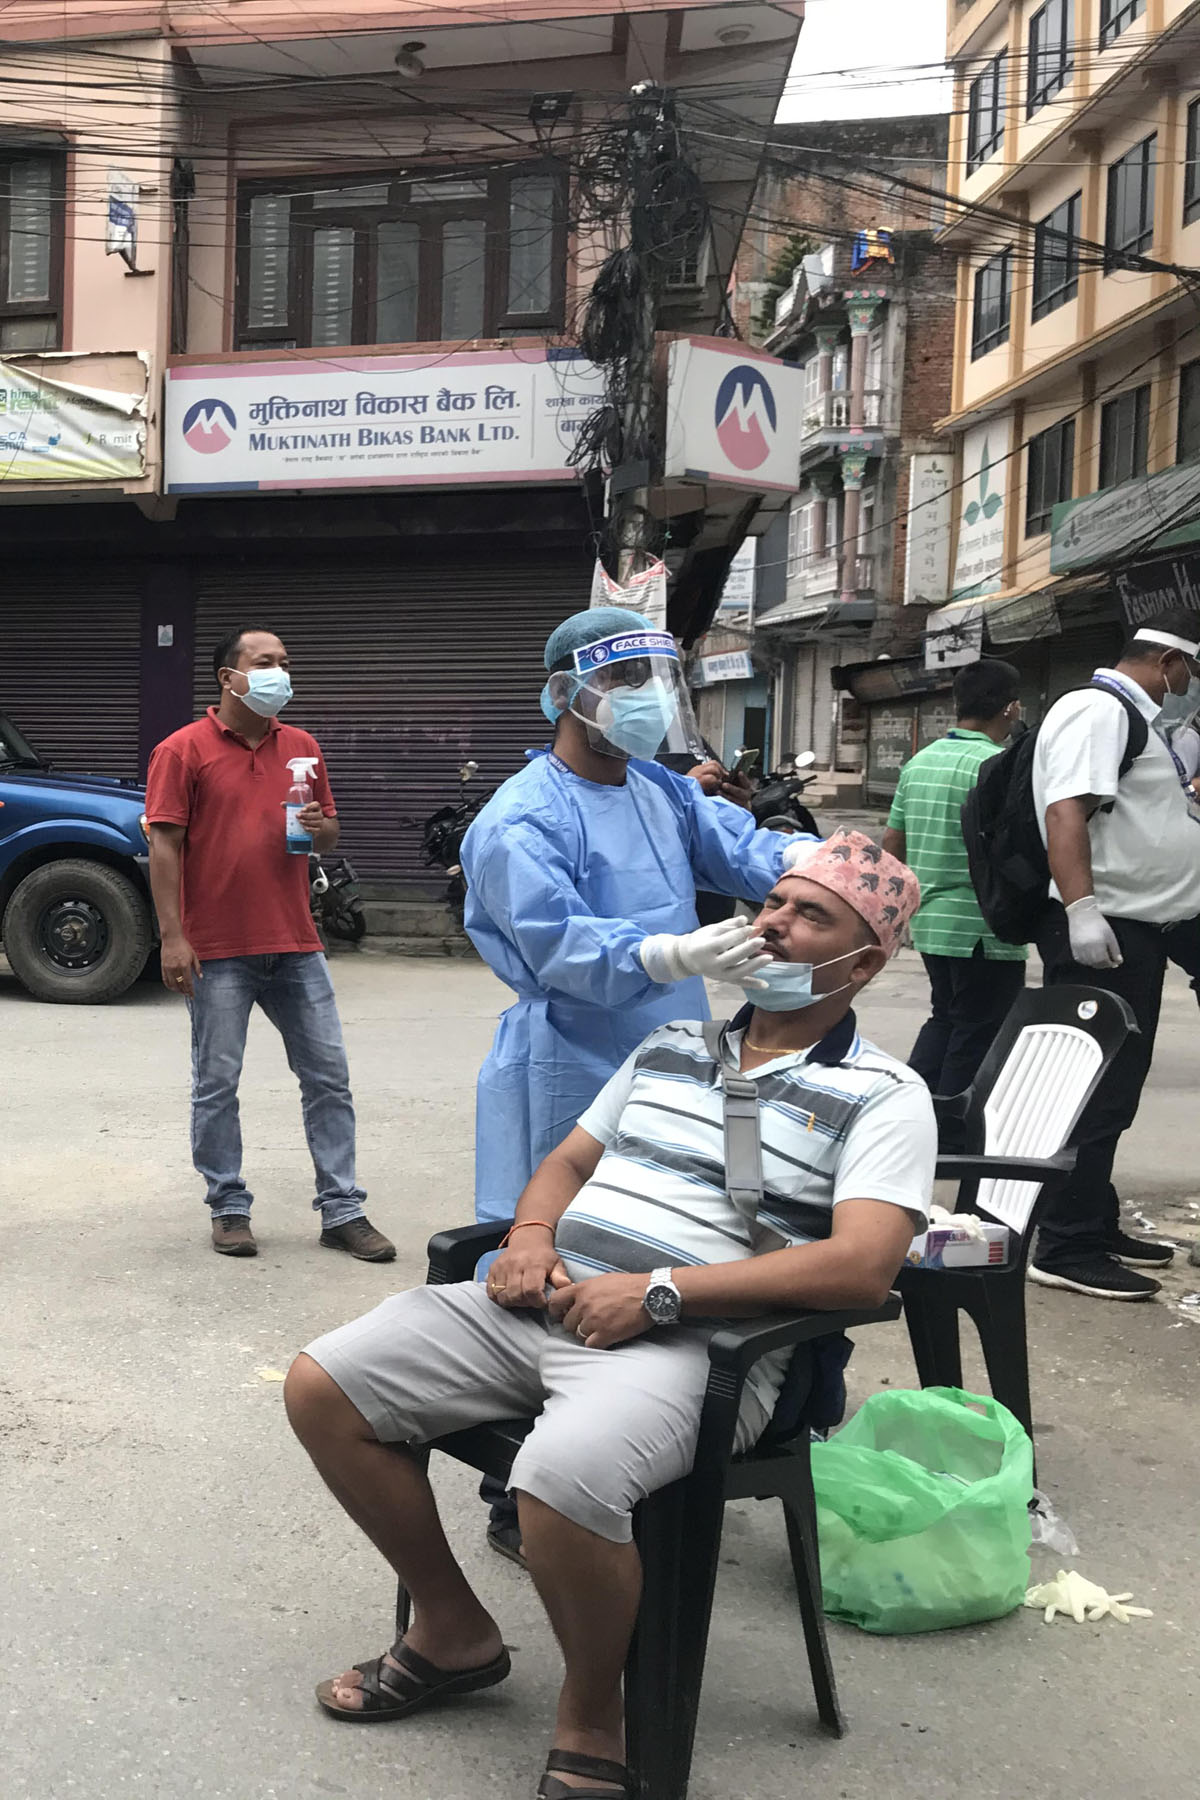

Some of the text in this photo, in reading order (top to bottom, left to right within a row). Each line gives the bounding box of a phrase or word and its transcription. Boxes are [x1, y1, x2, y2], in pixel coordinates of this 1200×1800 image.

[249, 385, 521, 425] मुक्तिनाथ विकास बैंक लि.
[615, 638, 647, 650] FACE
